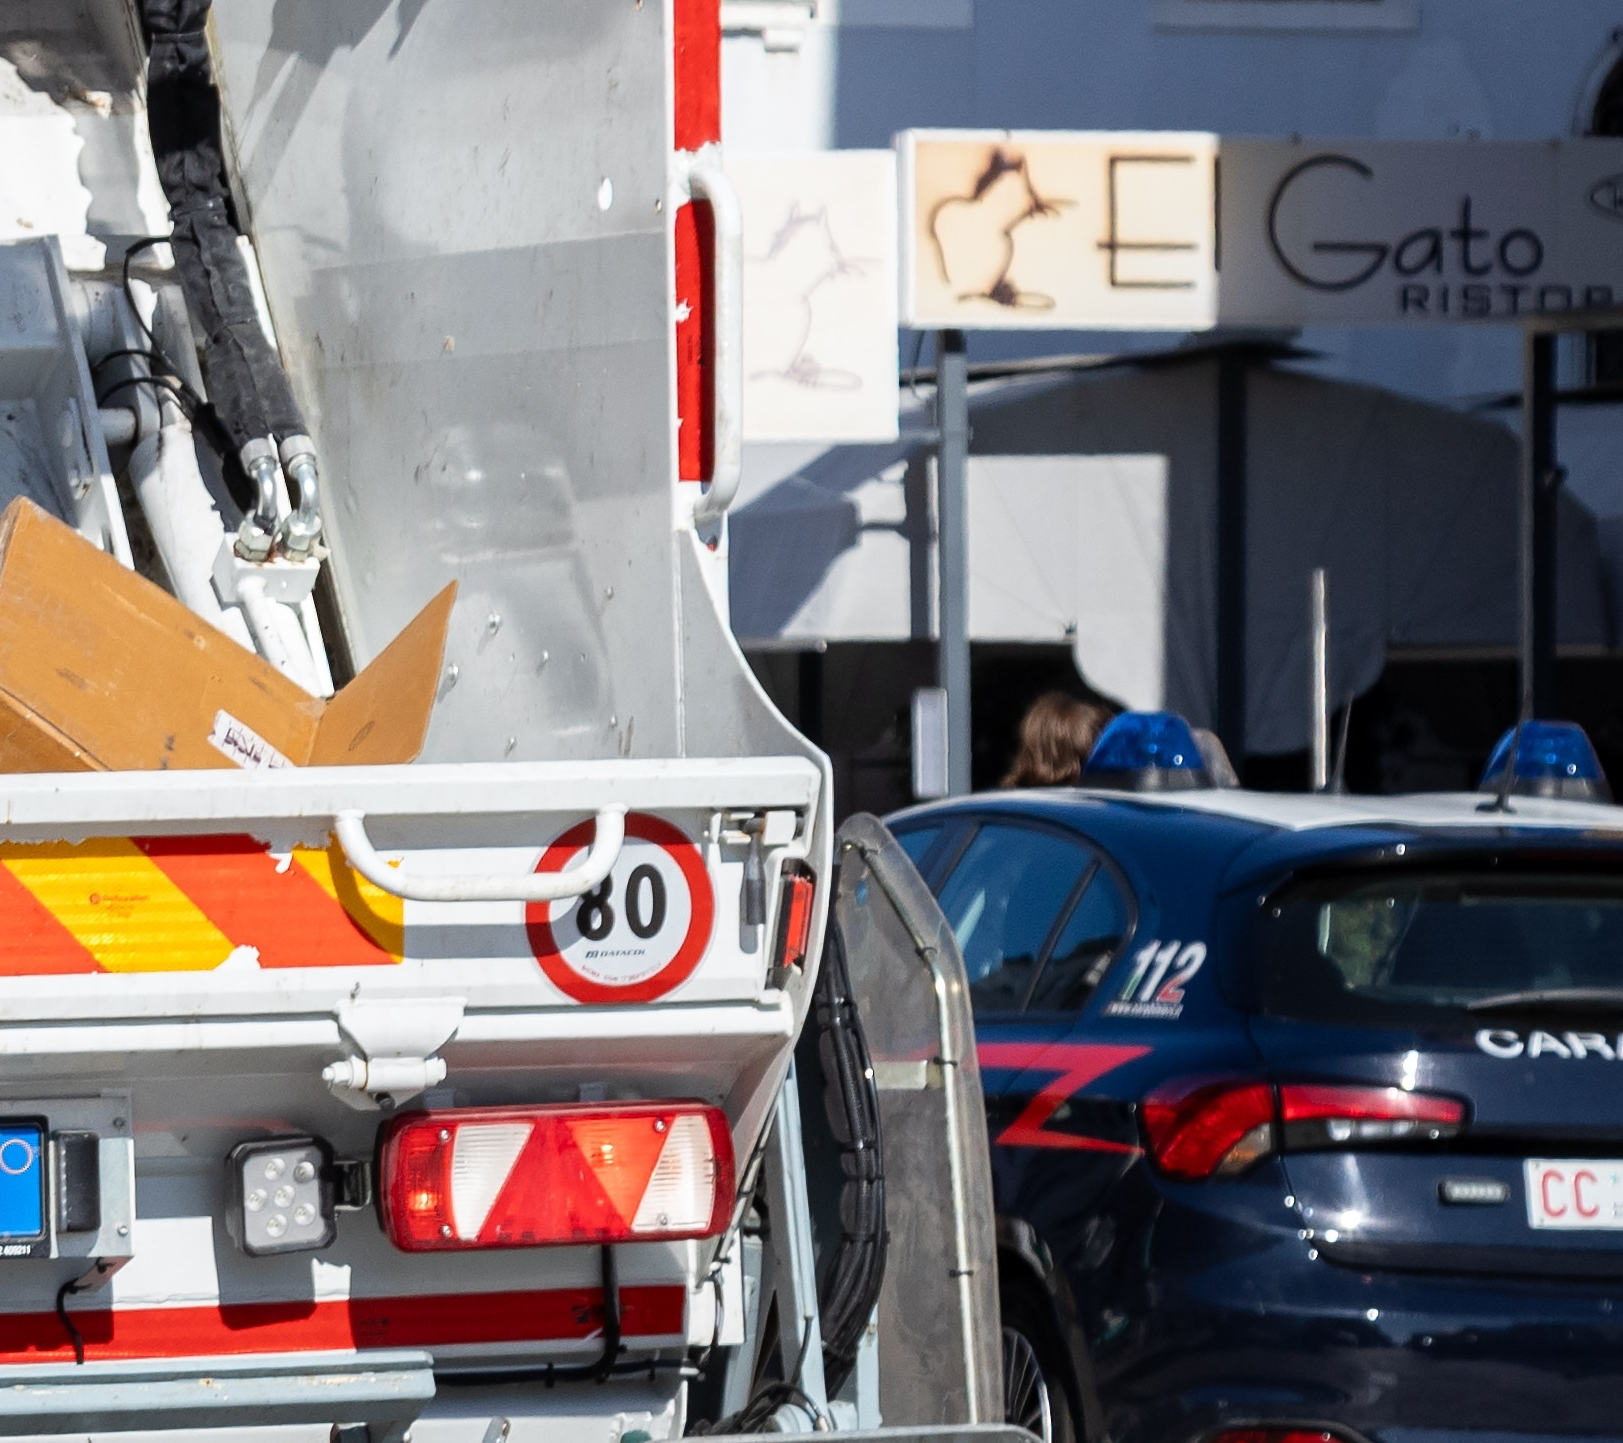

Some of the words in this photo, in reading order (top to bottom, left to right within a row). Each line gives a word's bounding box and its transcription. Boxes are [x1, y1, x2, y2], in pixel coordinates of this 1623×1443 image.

[1097, 154, 1222, 288] El
[1266, 154, 1545, 291] Gato
[576, 863, 667, 941] 80
[1121, 939, 1208, 1003] 112
[1475, 1028, 1623, 1060] CAR
[1541, 1169, 1600, 1218] CC
